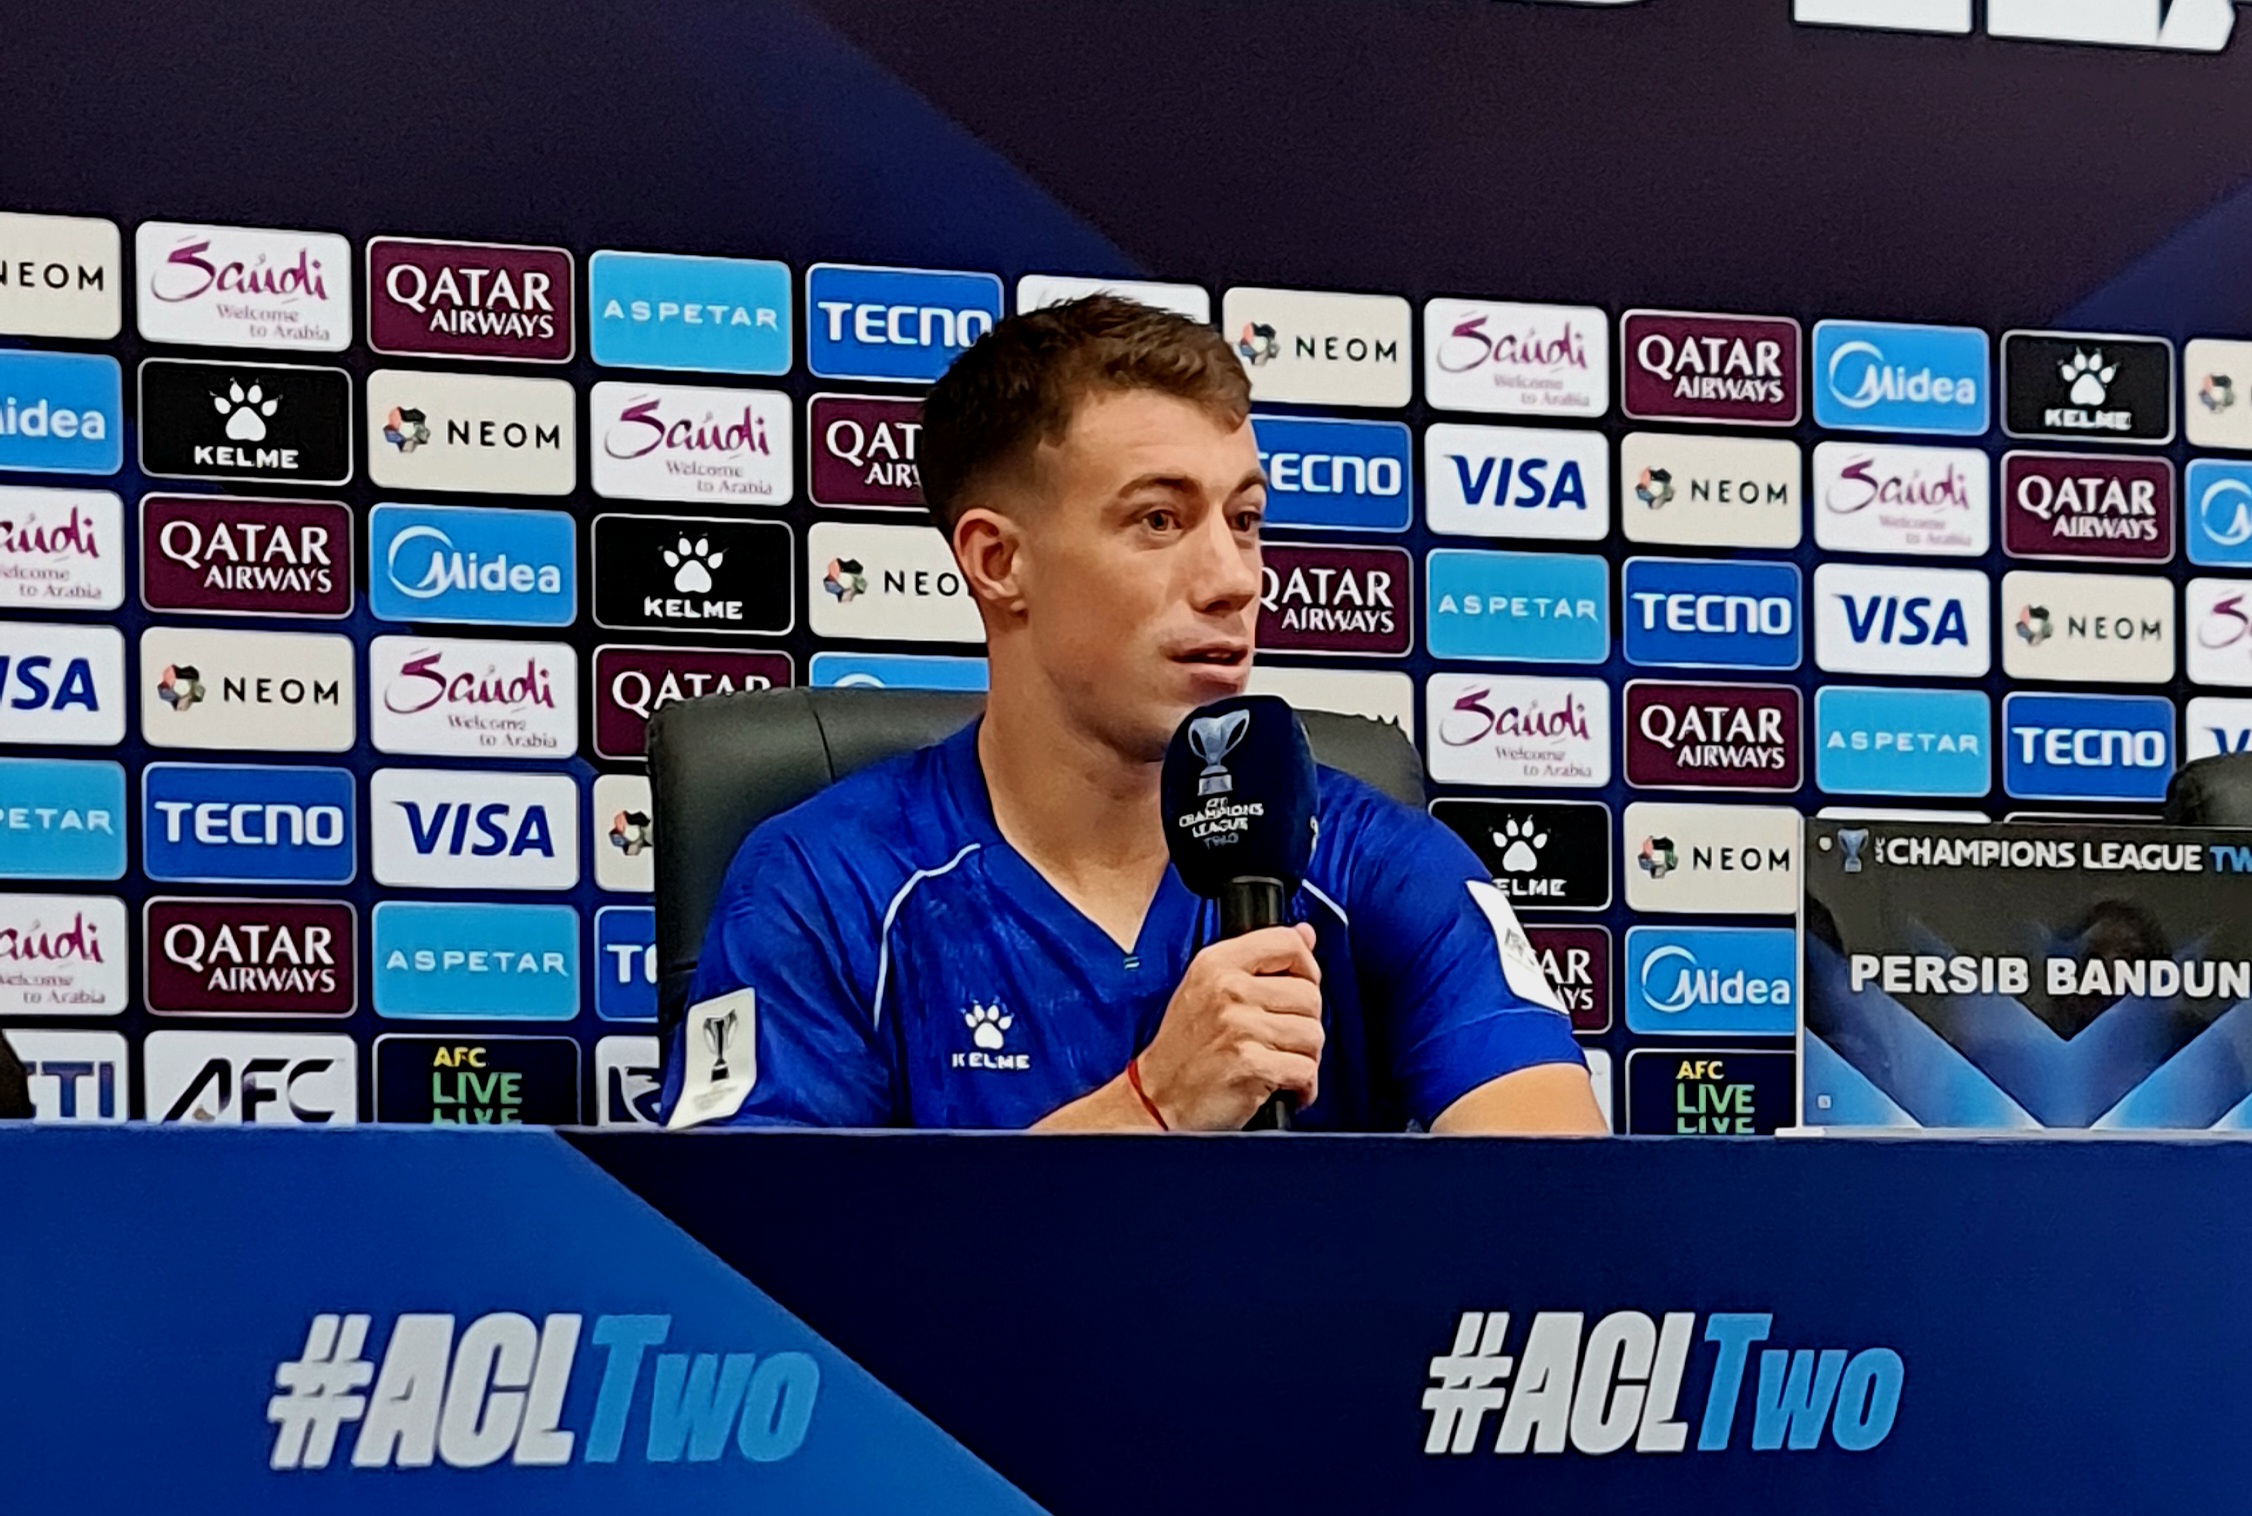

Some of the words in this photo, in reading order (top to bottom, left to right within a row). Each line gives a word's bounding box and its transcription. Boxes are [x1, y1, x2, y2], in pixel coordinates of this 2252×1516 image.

[386, 263, 554, 313] QATAR
[217, 303, 298, 323] Welcome
[429, 308, 554, 339] AIRWAYS
[603, 300, 778, 331] ASPETAR
[817, 301, 992, 347] TECNO
[250, 325, 268, 340] to
[274, 324, 331, 342] Arabia
[1296, 336, 1397, 362] NEOM
[1638, 334, 1782, 380] QATAR
[1494, 374, 1563, 390] Welcome
[1674, 375, 1783, 403] AIRWAYS
[1520, 391, 1537, 405] to
[1542, 391, 1590, 407] Arabia
[2044, 408, 2131, 430] KELME
[447, 419, 560, 449] NEOM
[827, 420, 923, 467] QAT
[194, 445, 299, 470] KELME
[665, 460, 742, 478] Welcome
[697, 480, 713, 494] to
[719, 479, 772, 496] Arabia
[1257, 452, 1401, 496] ECNO
[1444, 454, 1586, 509] VISA
[1692, 479, 1787, 503] NEOM
[2017, 475, 2156, 519] QATAR
[0, 505, 100, 558] audi
[2053, 514, 2158, 541] AIRWAYS
[159, 519, 331, 569] QATAR
[20, 584, 37, 597] to
[44, 583, 101, 599] Arabia
[203, 564, 332, 593] AIRWAYS
[885, 570, 959, 596] NEO
[644, 598, 742, 620] KELME
[1281, 606, 1394, 634] AIRWAYS
[1438, 593, 1598, 622] ASPETAR
[1633, 592, 1790, 635] TECNO
[1835, 594, 1968, 646] VISA
[2069, 616, 2161, 638] NEOM
[0, 655, 99, 711] SA
[223, 677, 338, 705] NEOM
[448, 715, 525, 731] Welcome
[1640, 704, 1784, 749] QATAR
[479, 732, 496, 747] to
[503, 733, 557, 749] Arabia
[1495, 746, 1565, 761] Welcome
[1826, 730, 1980, 756] ASPETAR
[2011, 727, 2166, 767] TECNO
[1523, 763, 1537, 777] to
[1543, 763, 1591, 778] Arabia
[1678, 744, 1785, 770] AIRWAYS
[0, 809, 113, 835] ETAR
[155, 802, 343, 846] TECNO
[395, 801, 554, 857] VISA
[1192, 817, 1248, 838] LEAGUE
[1693, 847, 1790, 871] NEOM
[1887, 838, 2076, 869] CHAMPIONS
[2083, 842, 2203, 871] LEAGUE
[2209, 845, 2252, 873] TW
[1492, 878, 1567, 897] ELME
[0, 912, 104, 963] audi
[165, 923, 334, 973] QATAR
[386, 950, 568, 976] ASPETAR
[1850, 954, 2030, 994] PERSIB
[2046, 957, 2251, 999] BANDUN
[208, 968, 335, 993] AIRWAYS
[24, 988, 40, 1003] to
[48, 987, 105, 1003] Arabia
[433, 1046, 486, 1067] AFC
[952, 1052, 1030, 1069] KELME
[1676, 1060, 1724, 1080] AFC
[24, 1061, 115, 1118] TI
[160, 1057, 335, 1124] AFC
[432, 1072, 522, 1105] LIVE
[1677, 1083, 1755, 1114] LIVE
[267, 1312, 820, 1470] #ACLTwo
[1421, 1311, 1905, 1455] #ACLTwo
